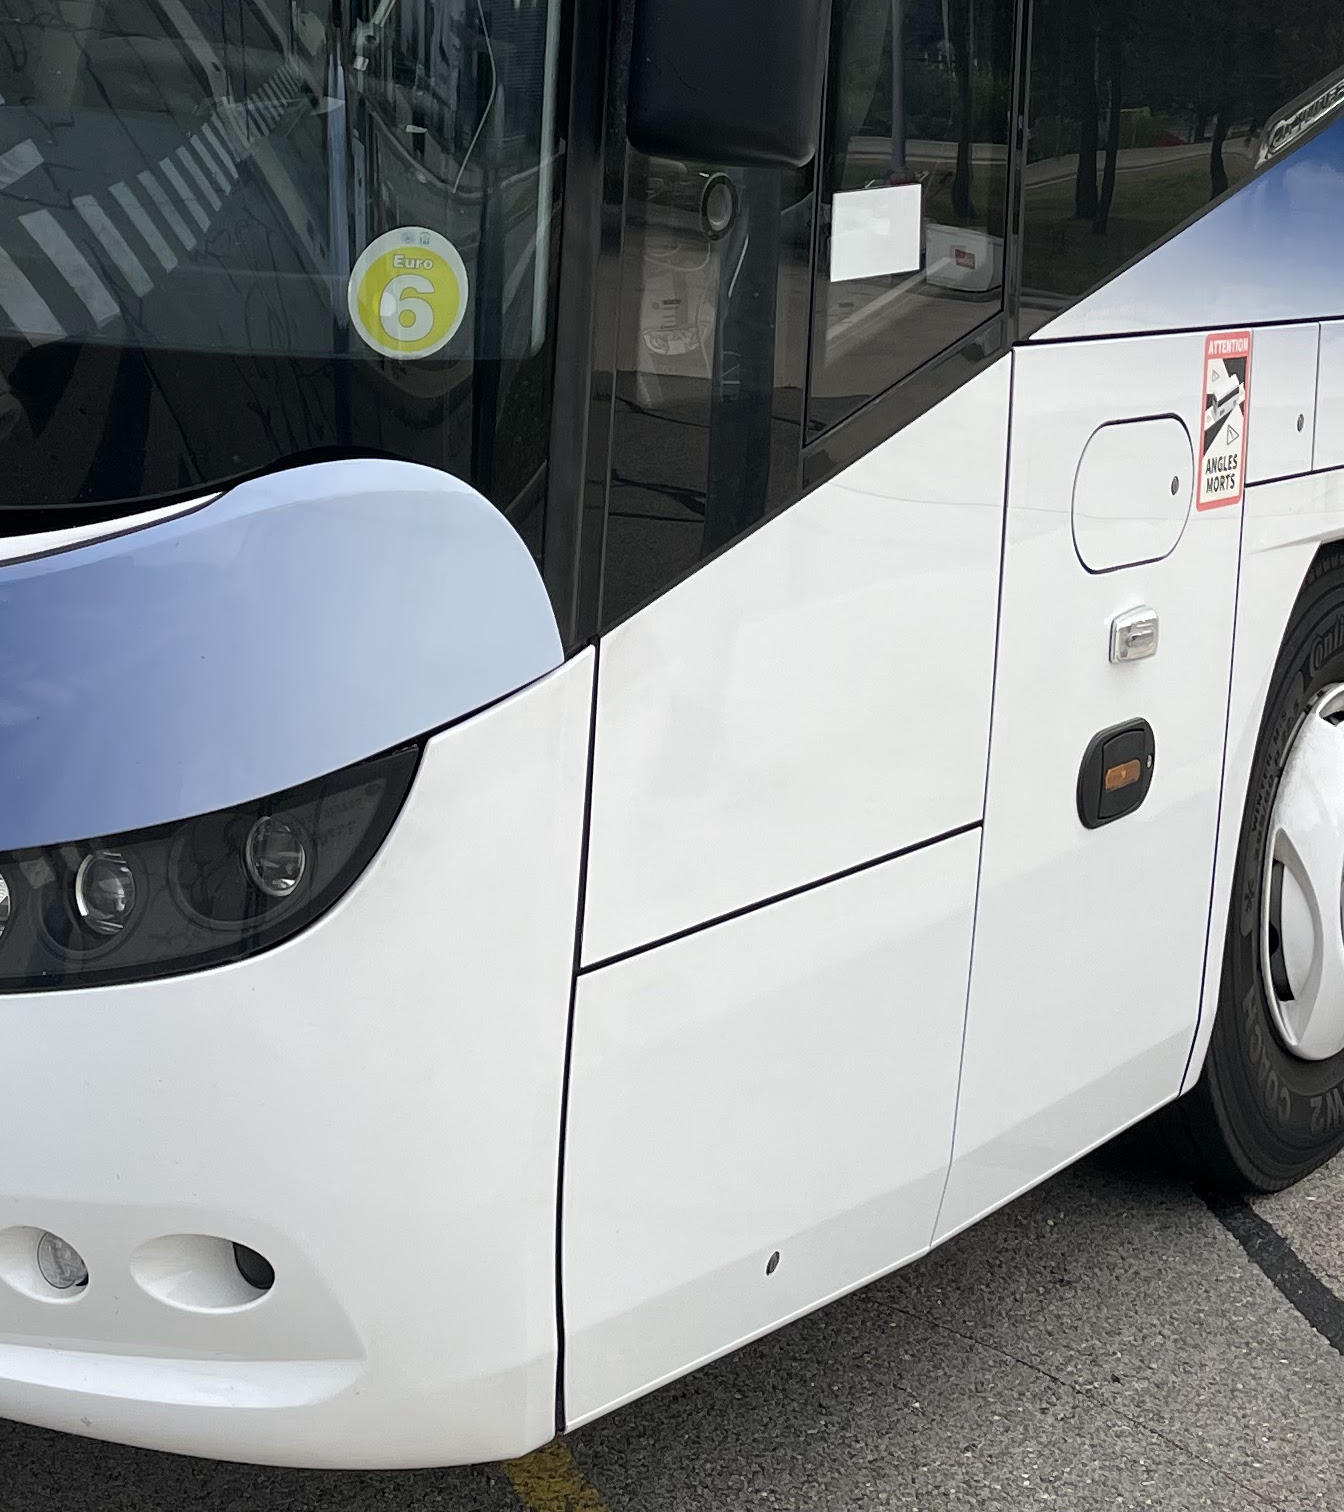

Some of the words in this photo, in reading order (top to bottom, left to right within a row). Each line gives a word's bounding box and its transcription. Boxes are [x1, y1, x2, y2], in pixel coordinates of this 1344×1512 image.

[392, 254, 435, 270] Euro
[379, 273, 436, 342] 6
[1208, 338, 1249, 355] ATTENTION
[1205, 453, 1238, 475] ANGLES
[1206, 473, 1236, 494] MORTS
